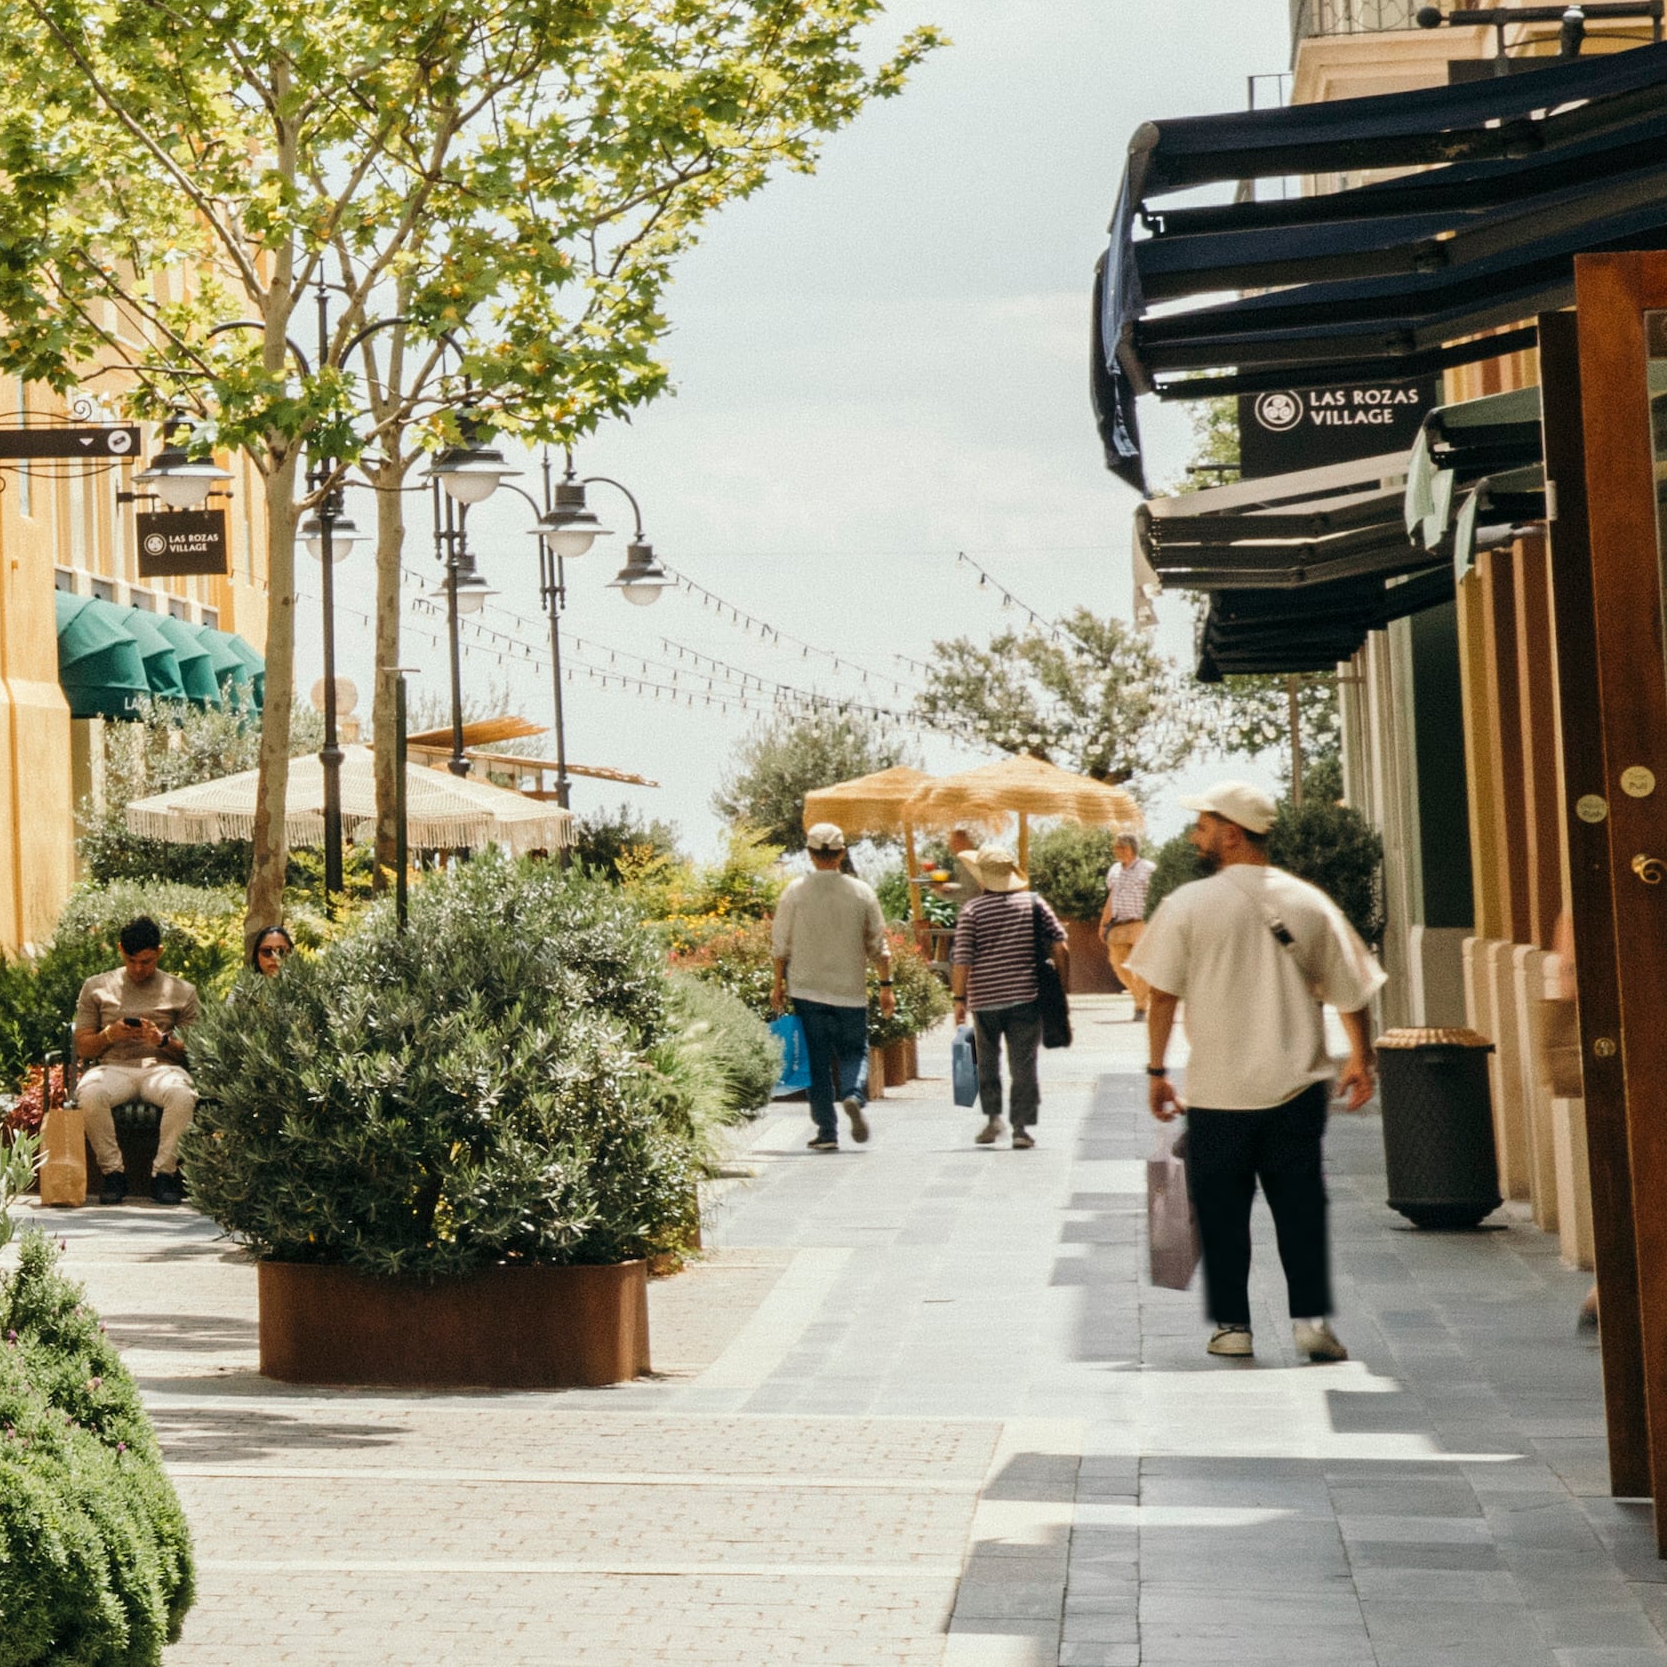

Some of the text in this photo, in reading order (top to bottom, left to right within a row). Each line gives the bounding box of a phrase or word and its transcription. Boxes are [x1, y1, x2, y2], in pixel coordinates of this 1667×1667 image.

[1309, 388, 1419, 407] LAS ROZAS
[1310, 408, 1394, 426] VILLAGE
[169, 533, 219, 543] LAS ROZAS
[169, 543, 208, 553] VILLAGE
